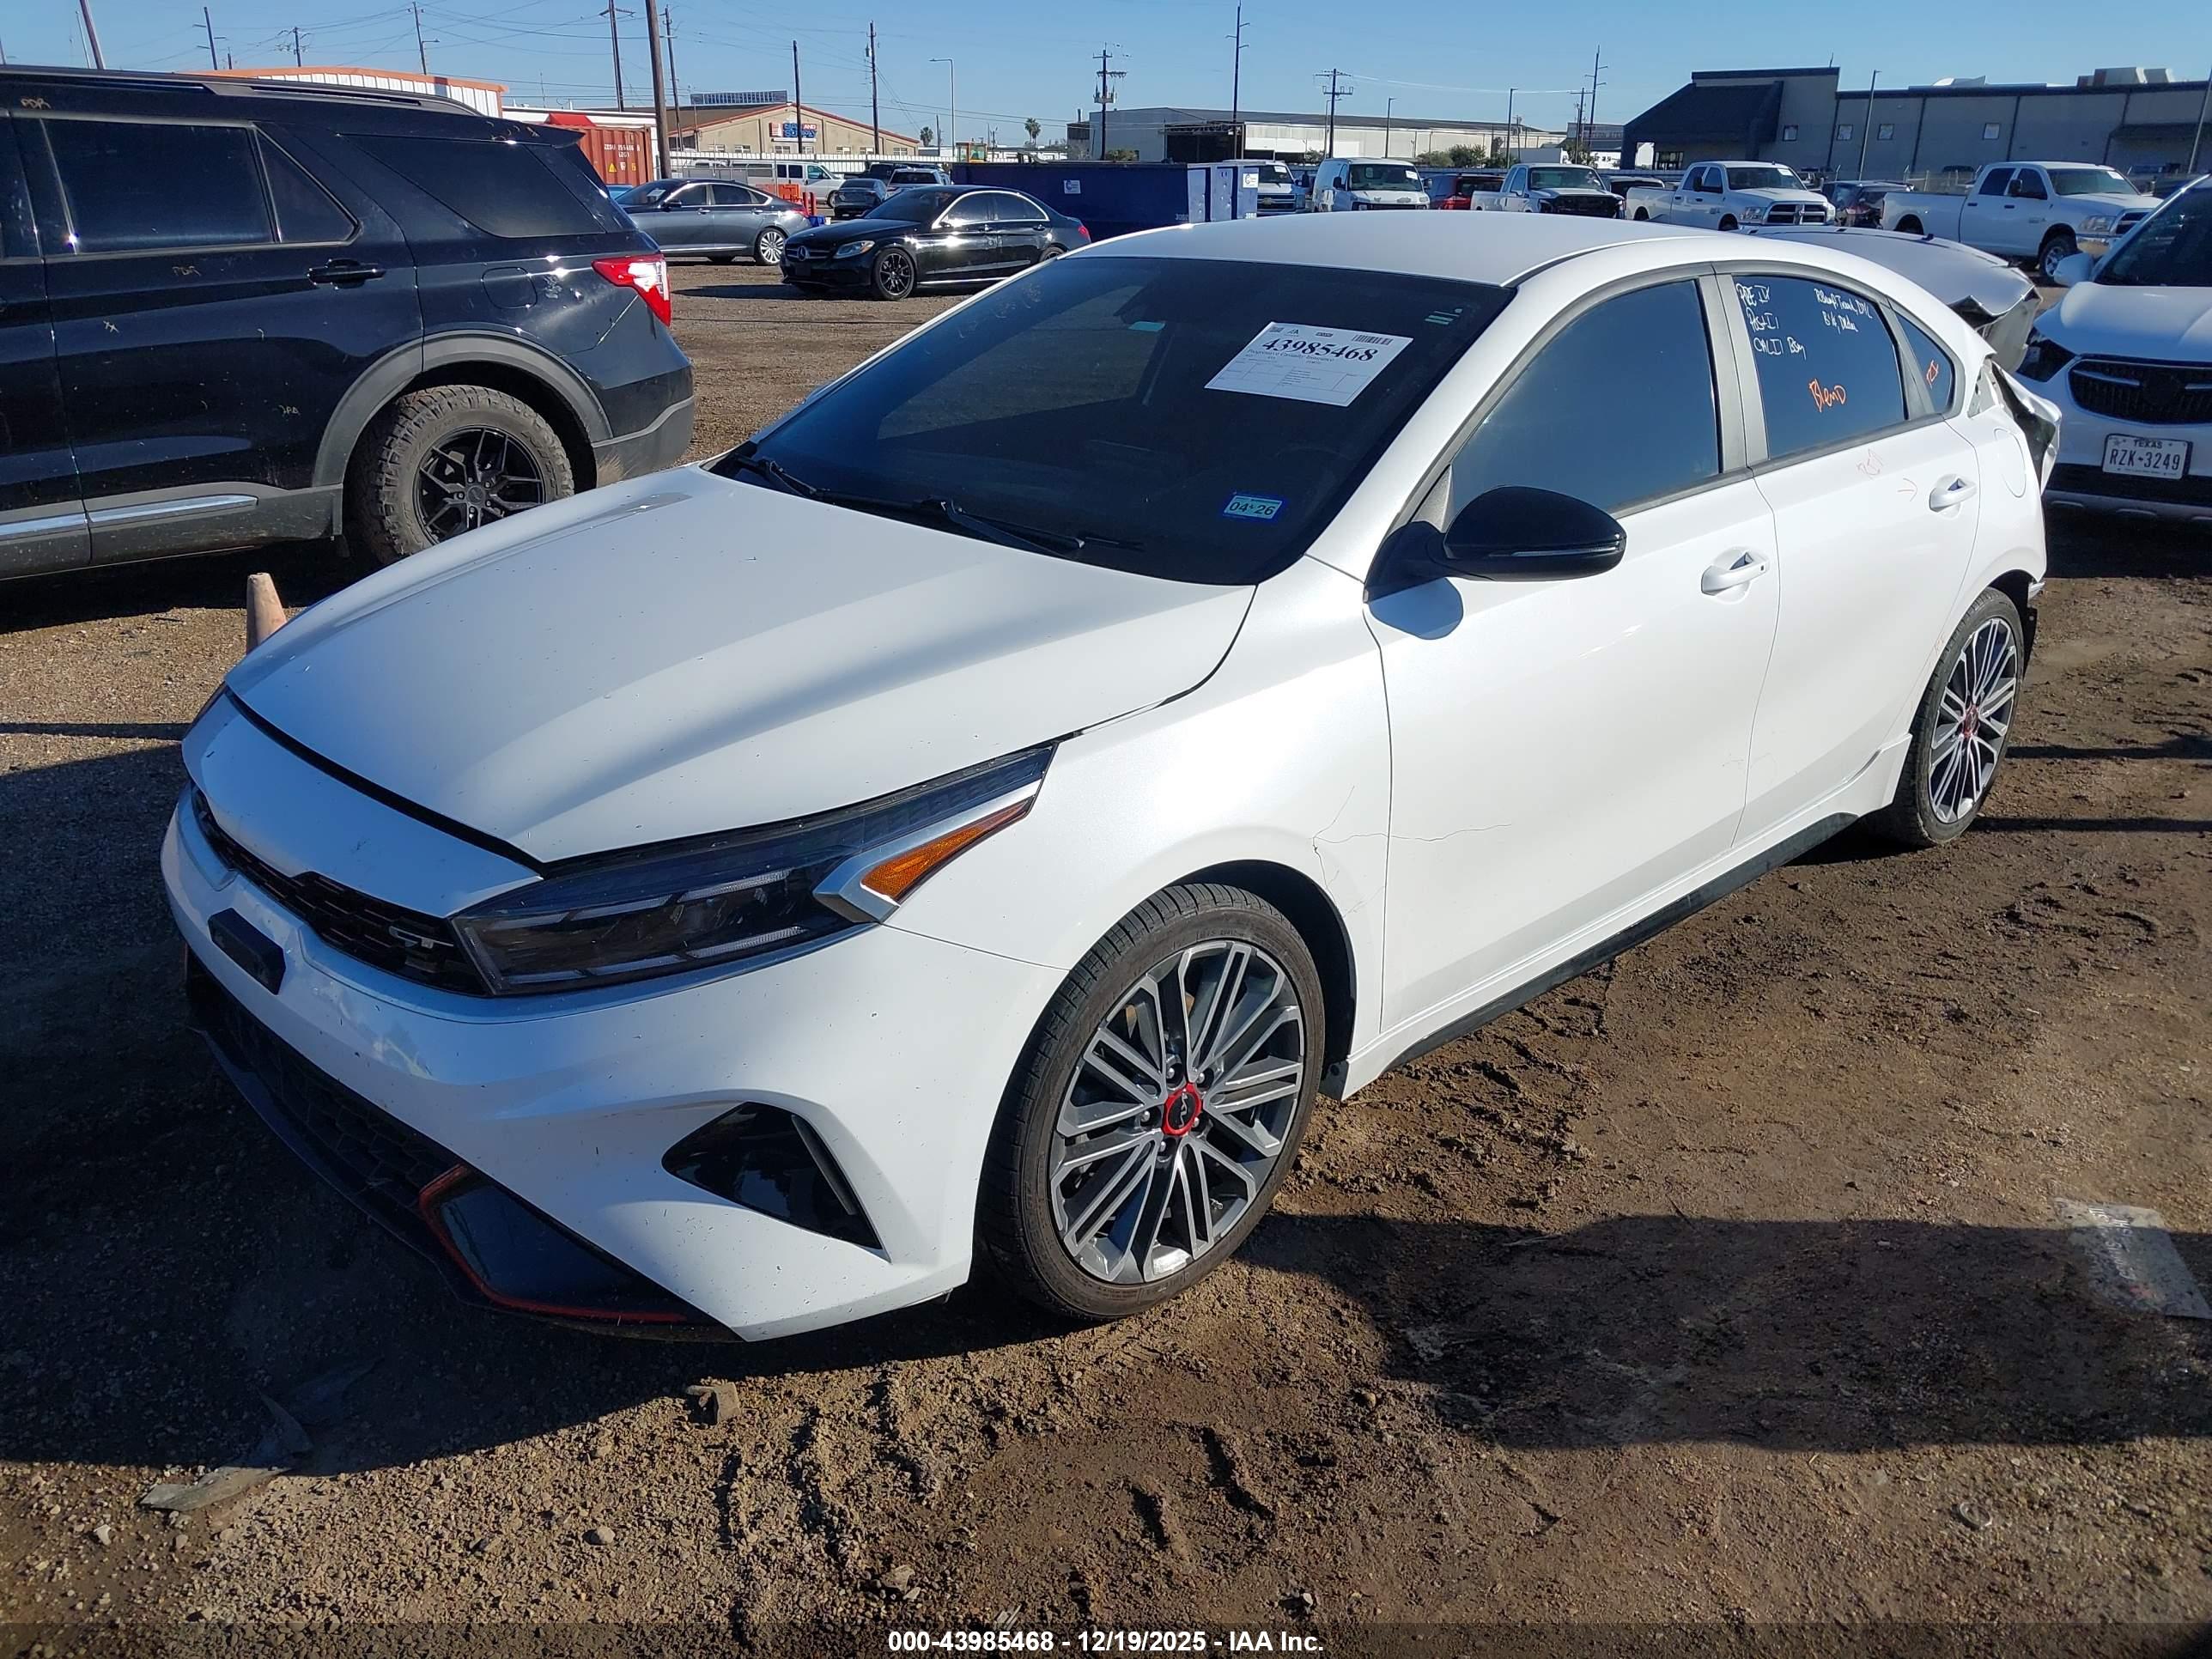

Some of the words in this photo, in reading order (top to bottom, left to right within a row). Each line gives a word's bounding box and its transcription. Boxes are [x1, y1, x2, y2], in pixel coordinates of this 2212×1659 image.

[1262, 337, 1379, 362] 43985468
[2134, 439, 2163, 450] TEXAS
[1254, 505, 1276, 516] 26
